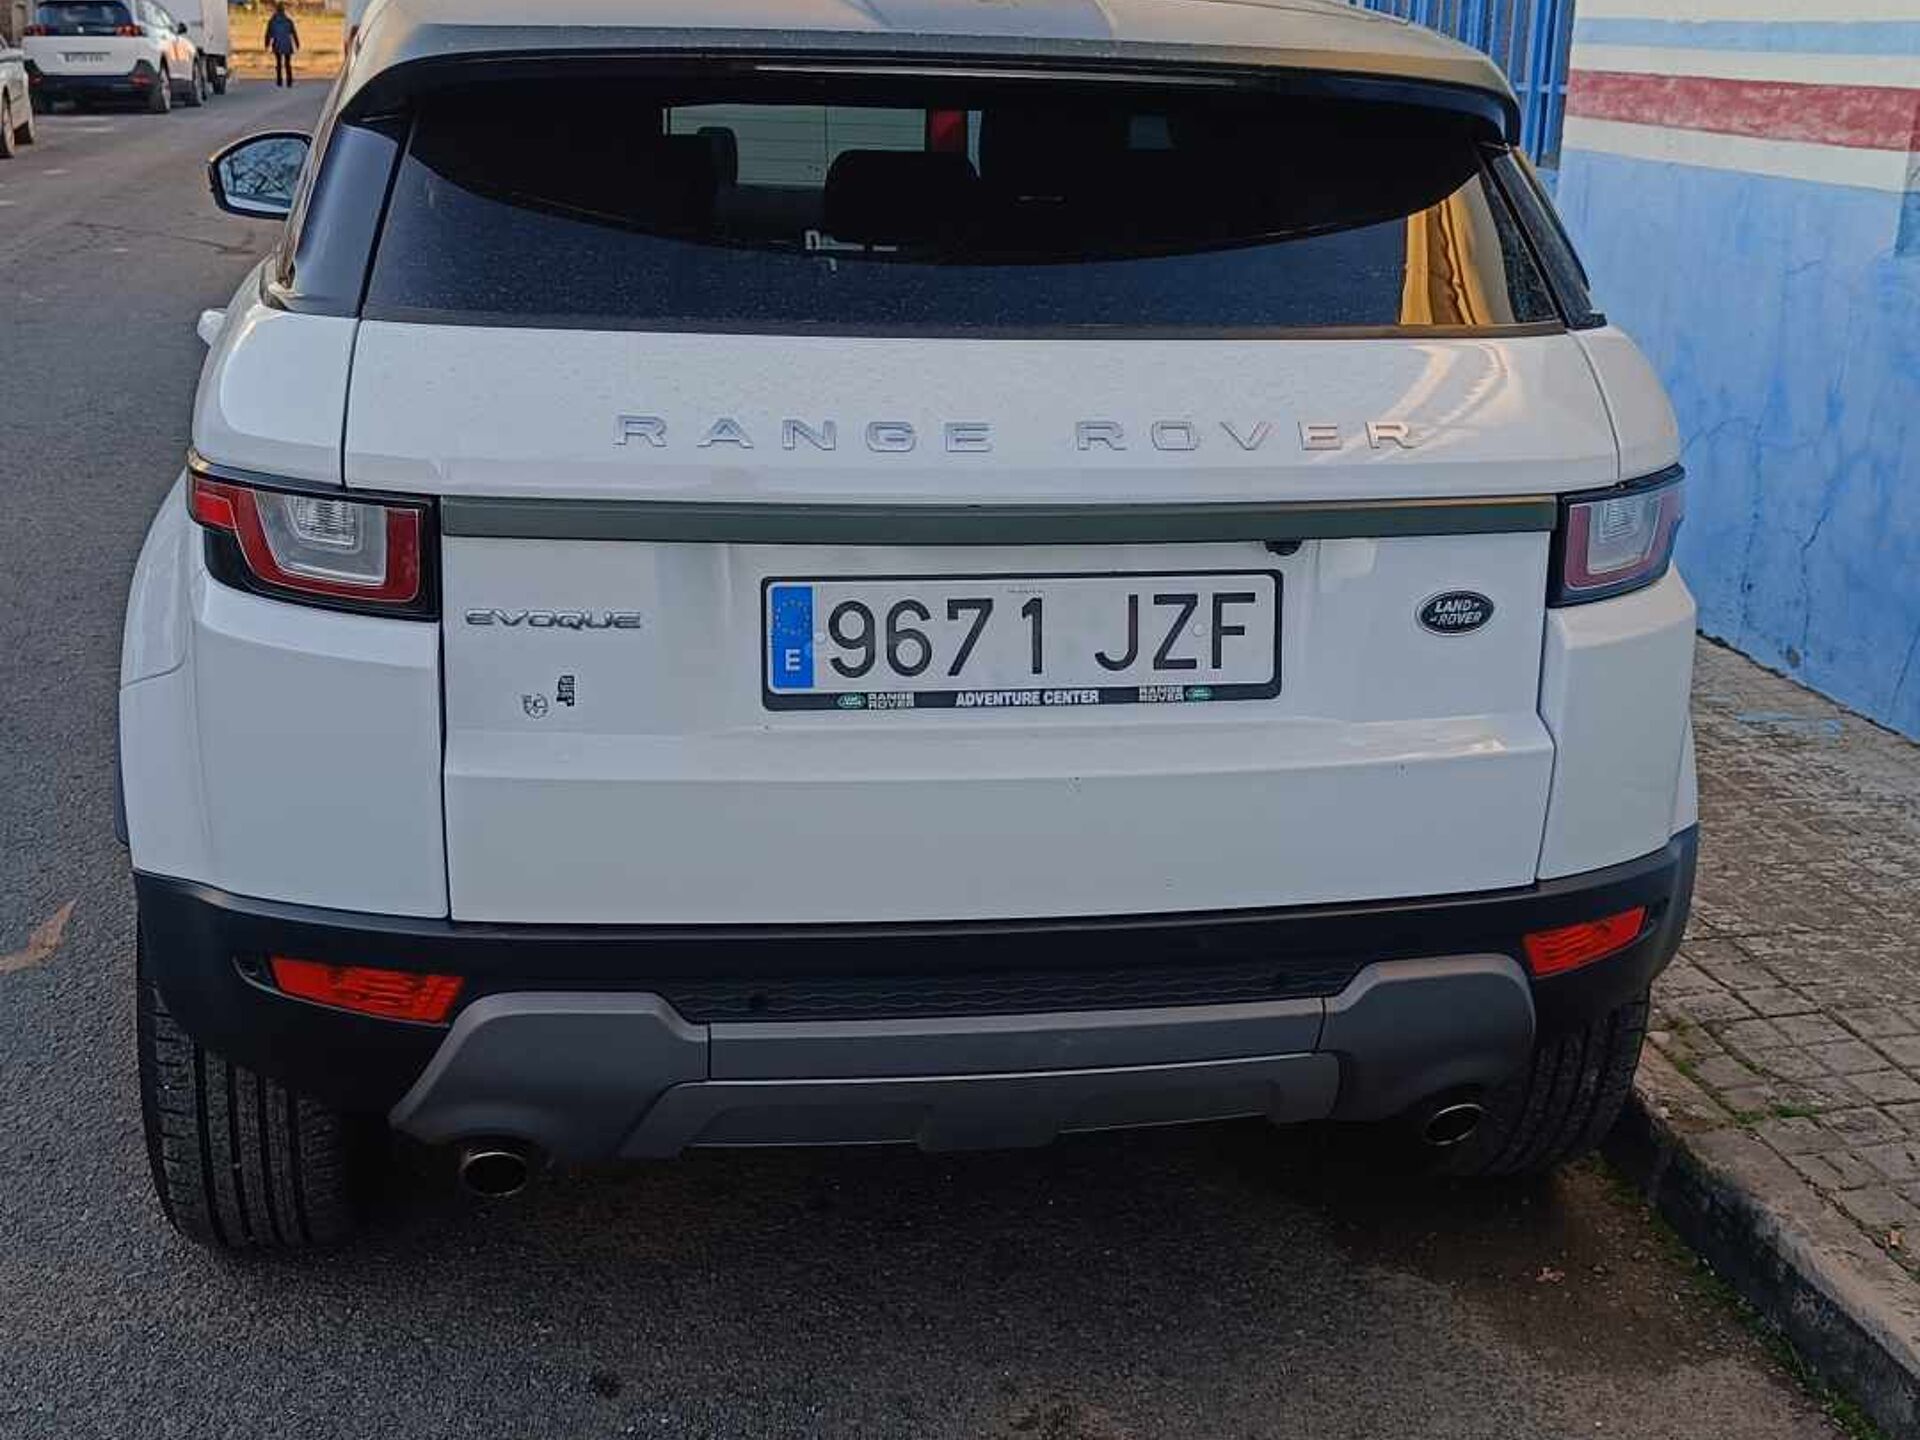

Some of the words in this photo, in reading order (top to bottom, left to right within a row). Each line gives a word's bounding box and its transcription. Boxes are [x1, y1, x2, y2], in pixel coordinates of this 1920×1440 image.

[612, 414, 992, 453] RANGE
[1074, 420, 1421, 451] ROVER
[466, 607, 641, 630] EVOQUE
[827, 596, 1044, 679] 9671
[1094, 591, 1256, 671] JZF
[786, 650, 800, 671] E
[955, 691, 1040, 707] ADVENTURE
[1044, 689, 1099, 704] CENTER
